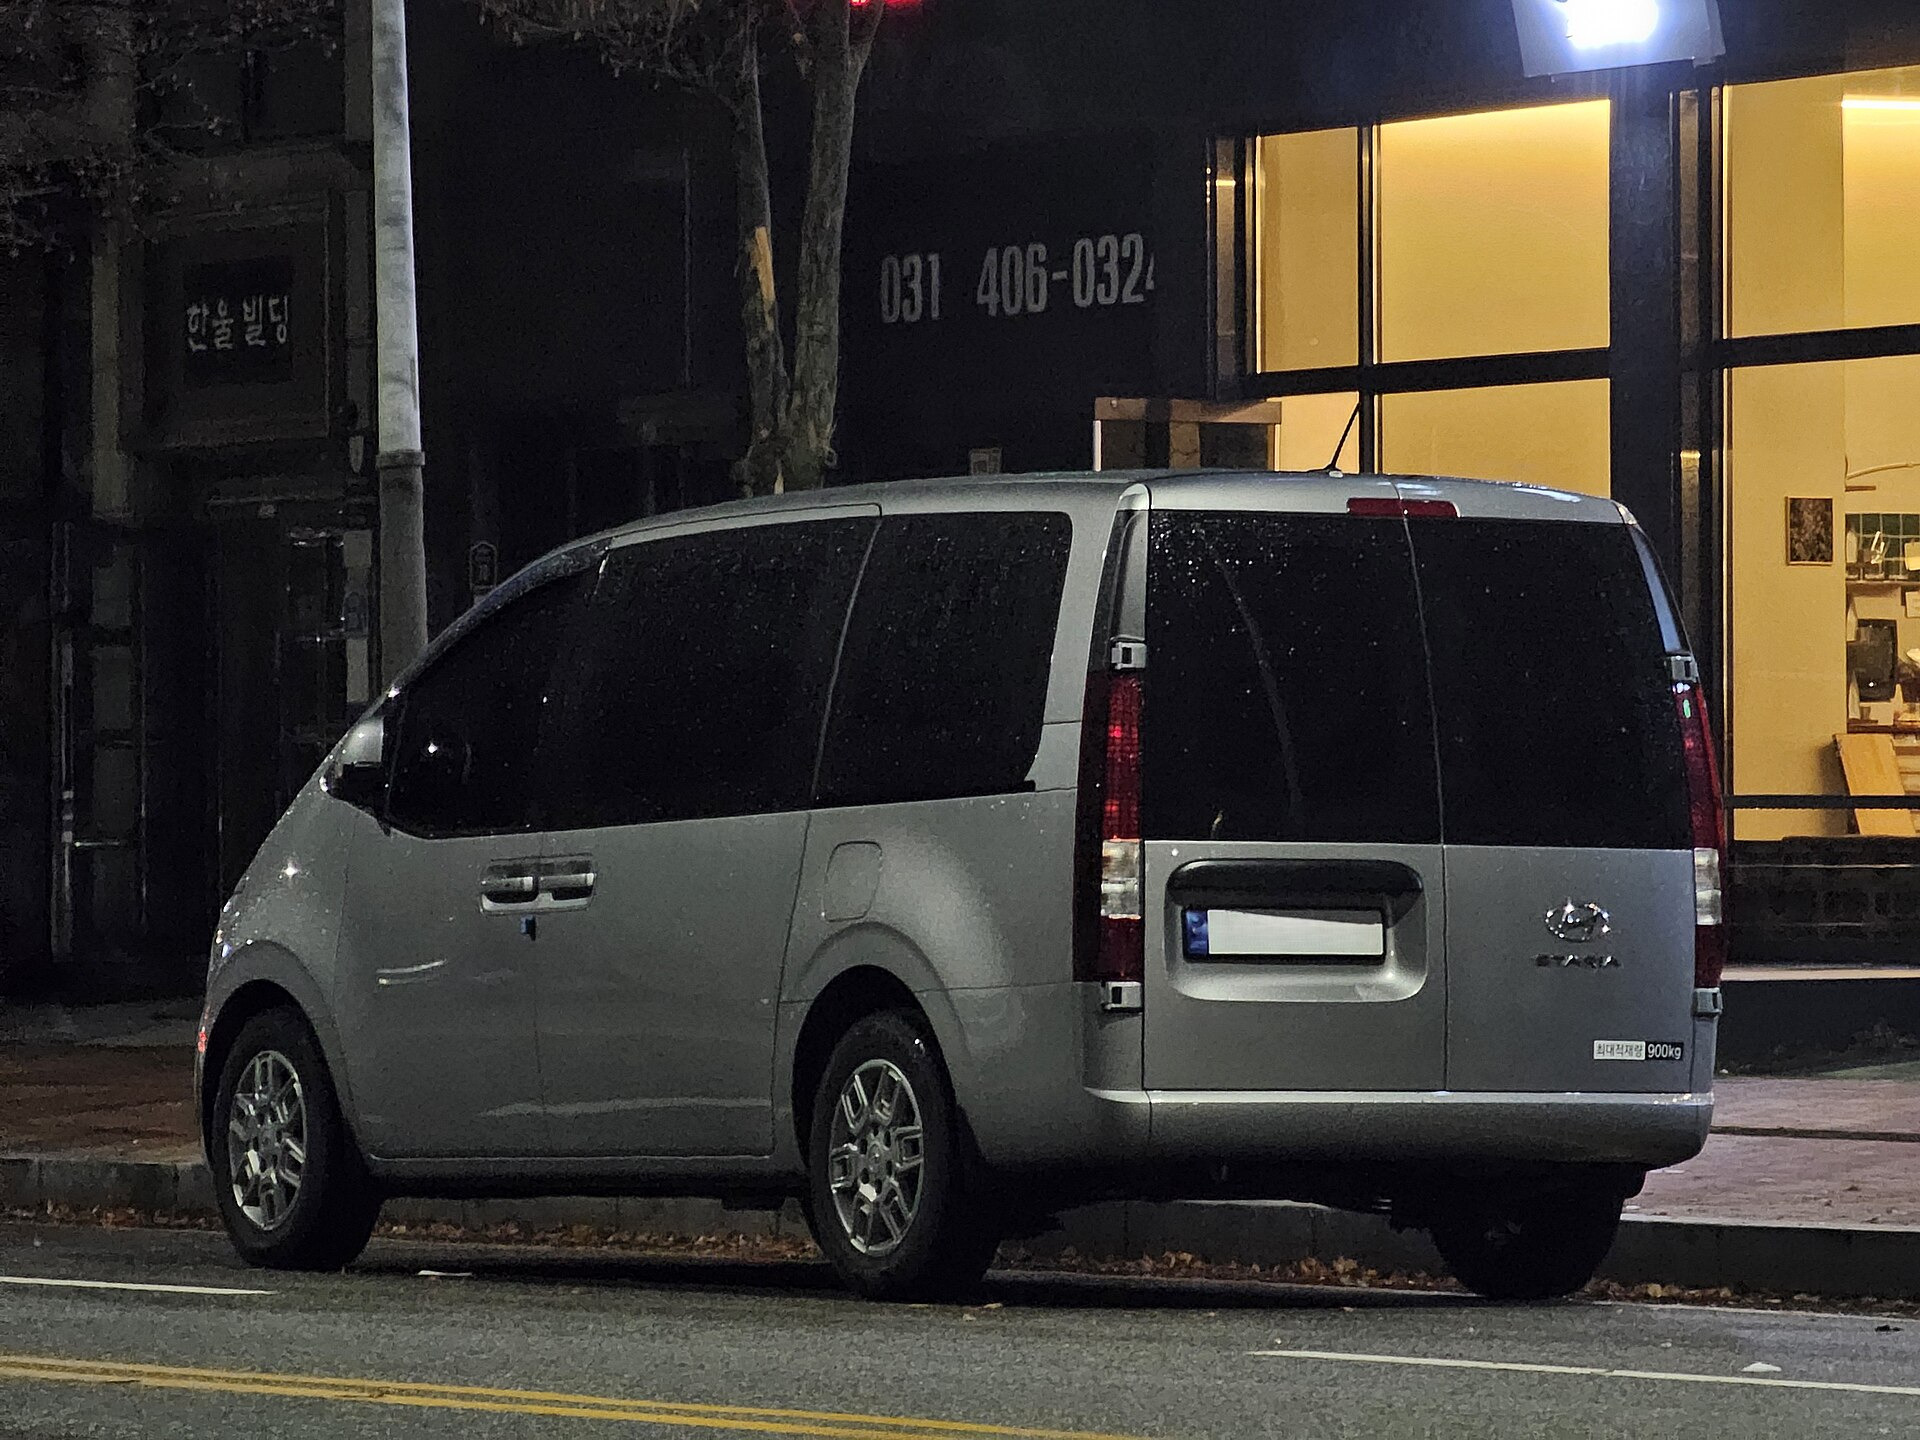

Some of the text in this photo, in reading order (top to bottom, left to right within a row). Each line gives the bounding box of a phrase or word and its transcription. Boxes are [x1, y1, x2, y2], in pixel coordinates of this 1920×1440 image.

[880, 253, 940, 323] 031
[242, 294, 288, 346] 빌딩
[1647, 1043, 1682, 1059] 900kg
